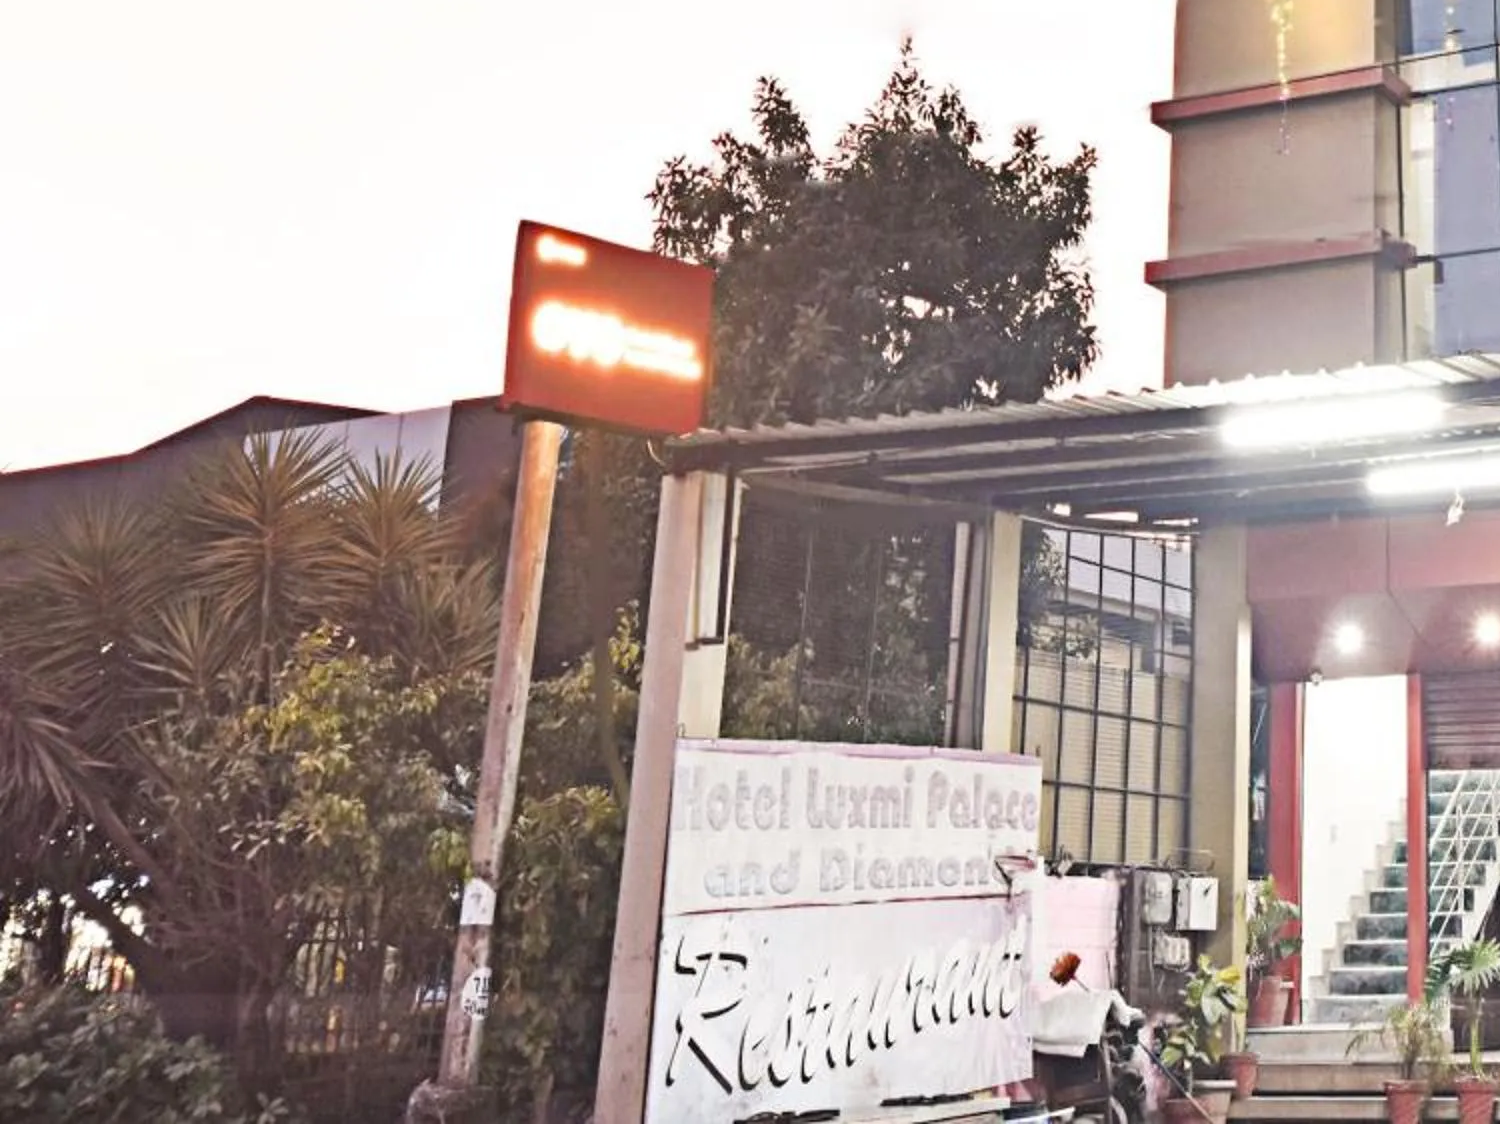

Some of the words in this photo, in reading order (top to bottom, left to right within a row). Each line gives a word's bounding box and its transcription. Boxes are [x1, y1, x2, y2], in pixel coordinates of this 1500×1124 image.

[674, 764, 791, 832] Hotel
[807, 764, 914, 831] Luxmi
[926, 769, 1039, 832] Palace
[703, 842, 801, 898] and
